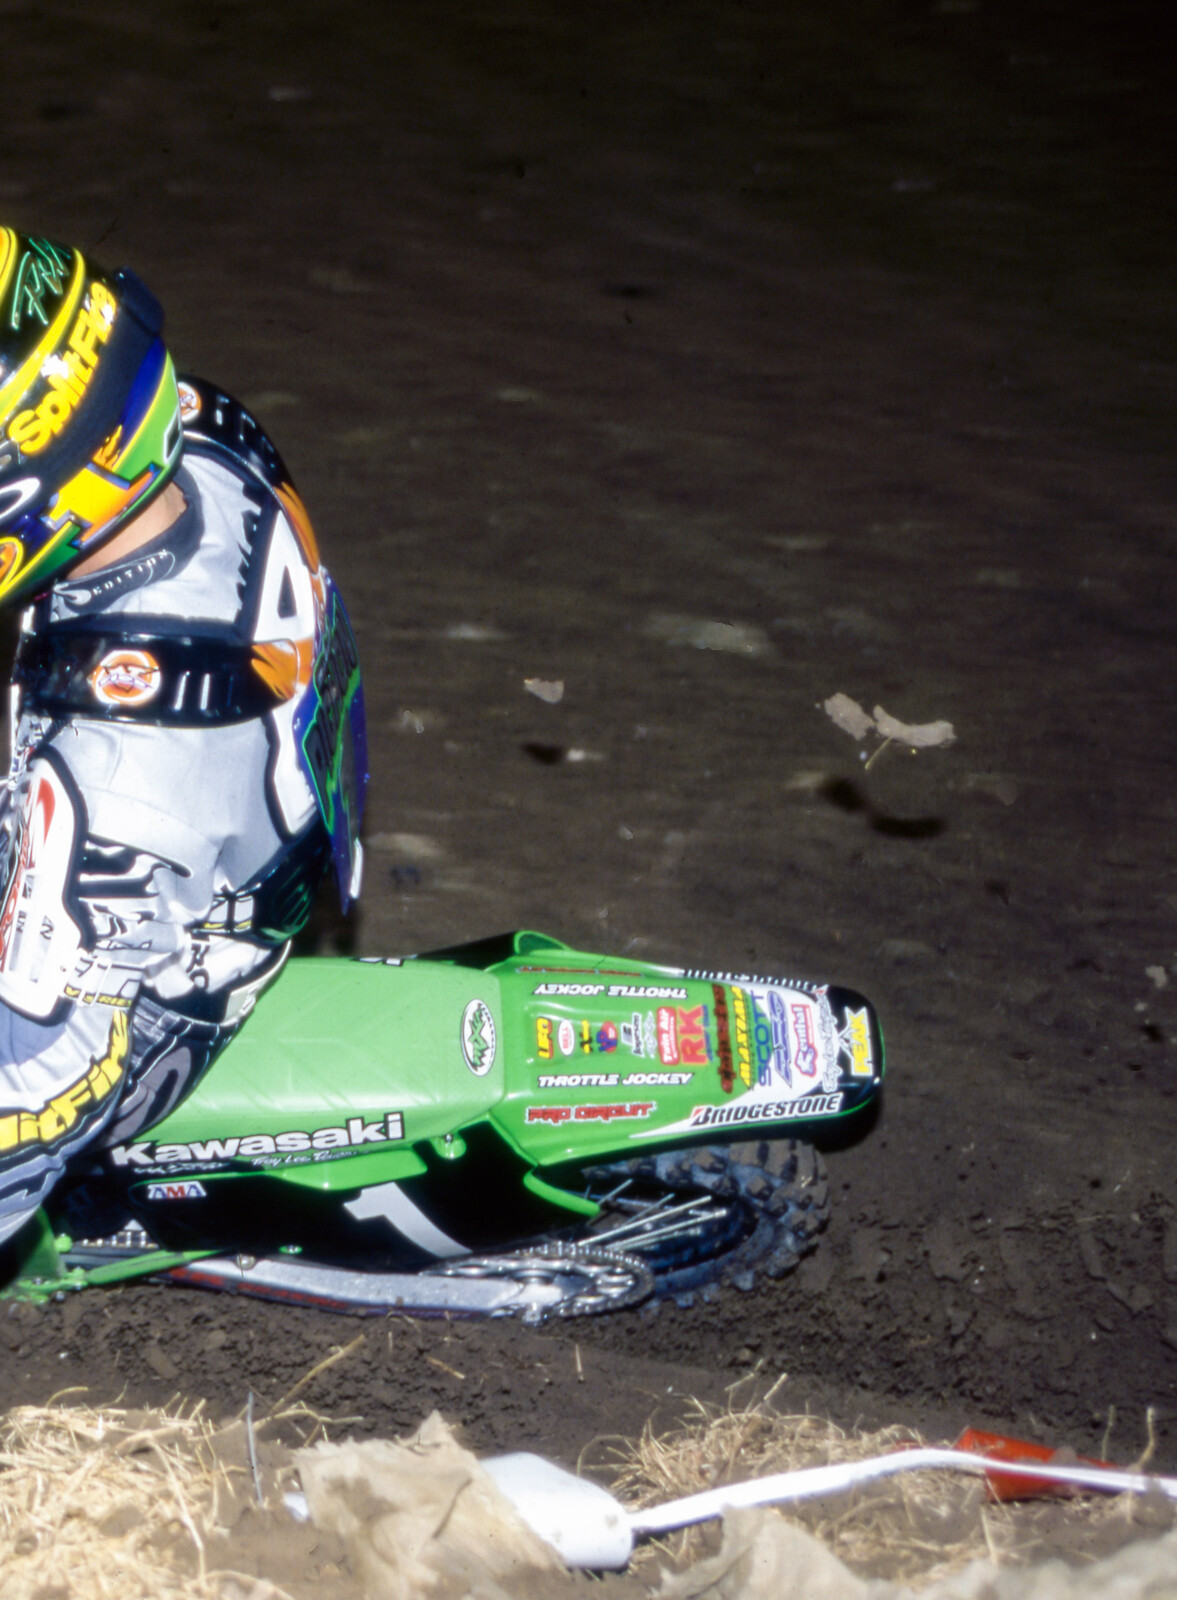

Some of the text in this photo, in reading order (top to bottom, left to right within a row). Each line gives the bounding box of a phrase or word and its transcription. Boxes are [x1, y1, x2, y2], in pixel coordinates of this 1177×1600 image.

[534, 983, 688, 999] THROTTLE JOCKEY
[678, 1004, 708, 1064] RK
[750, 989, 772, 1087] SCOTT
[847, 1011, 871, 1075] PEAK
[538, 1072, 694, 1088] THROTTLE JOCKEY
[526, 1102, 656, 1125] PRO CIRCUIT
[691, 1094, 843, 1128] BRIDGESTONE
[110, 1112, 405, 1167] Kawasaki
[251, 1155, 282, 1168] Troy
[284, 1154, 311, 1164] Lee
[149, 1182, 203, 1198] AMA
[343, 1181, 473, 1258] 1
